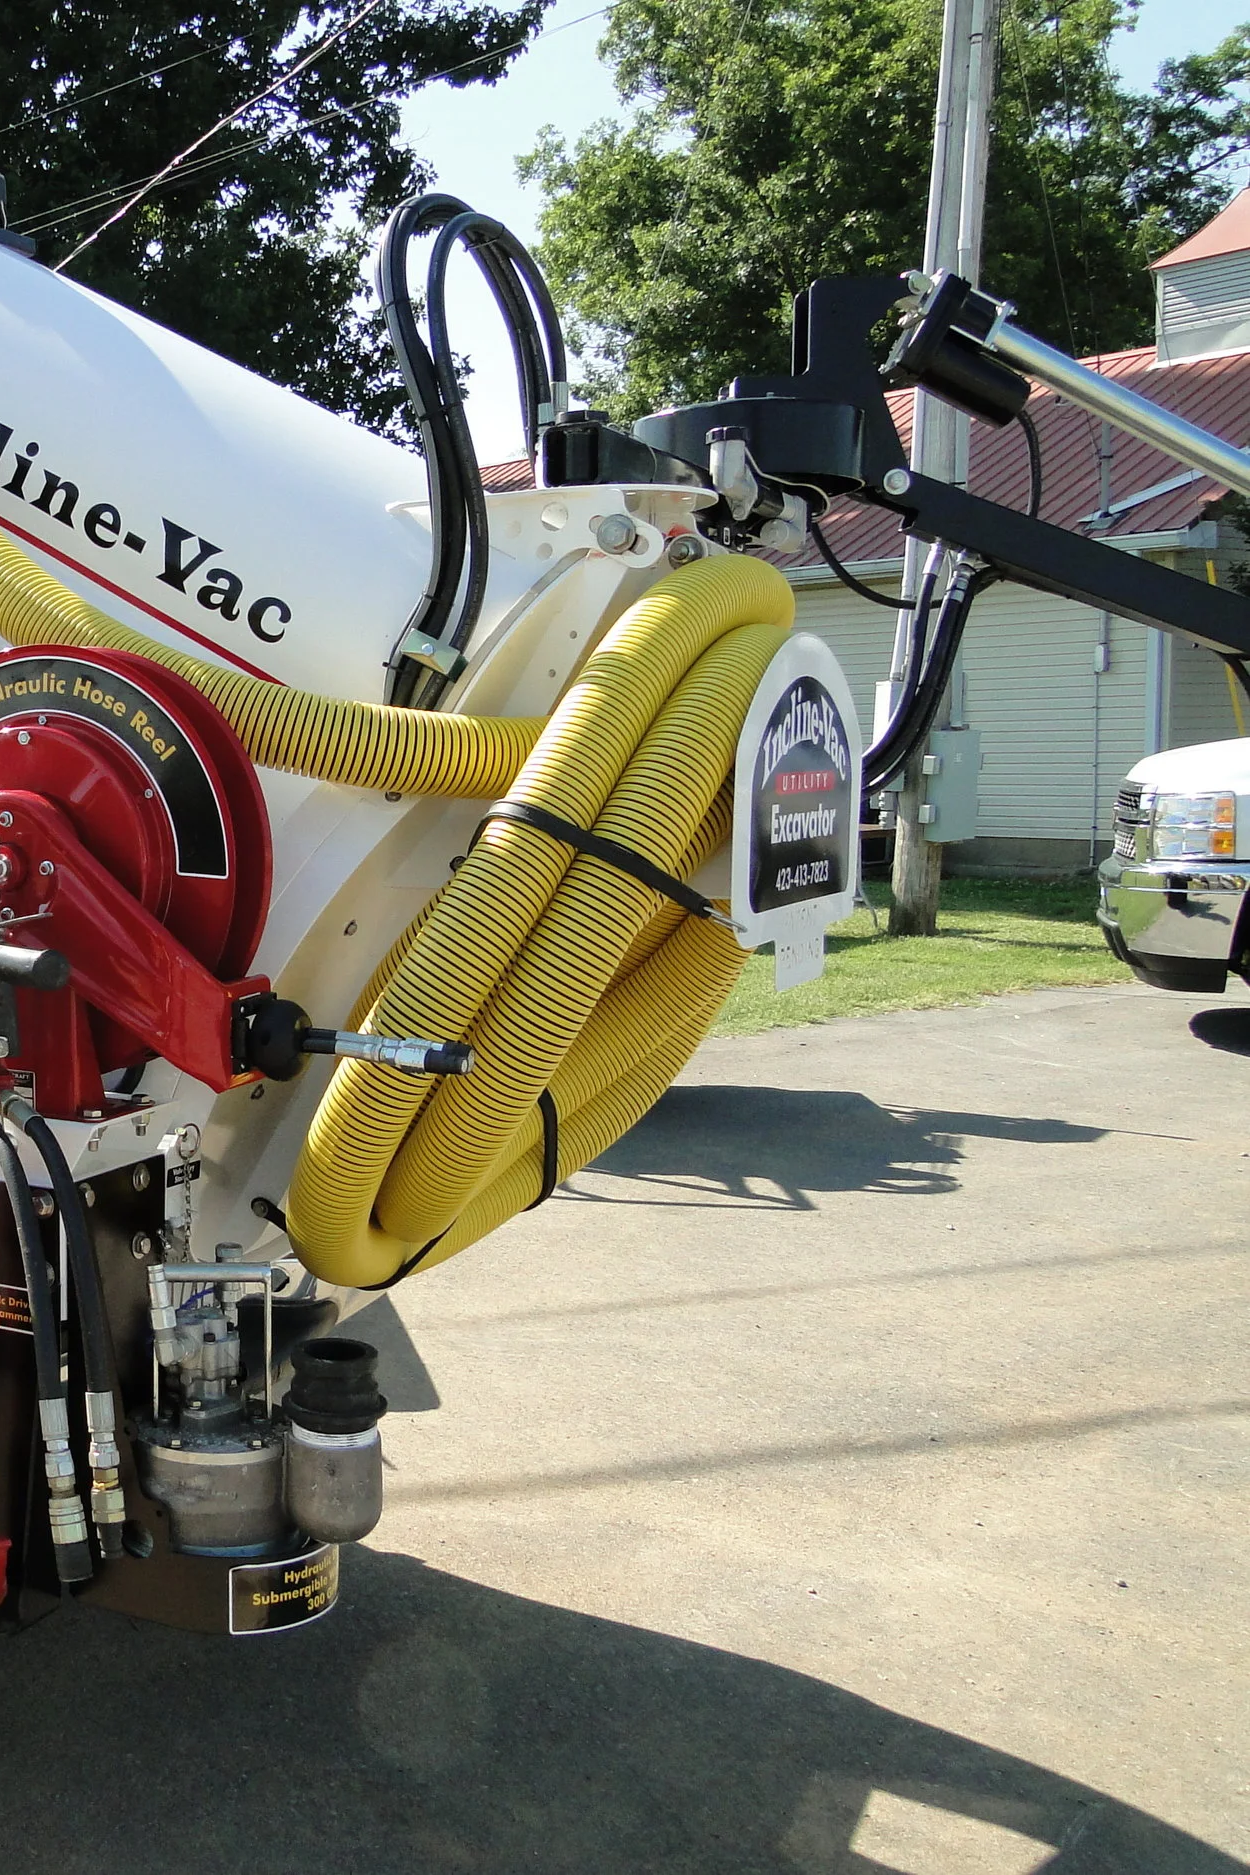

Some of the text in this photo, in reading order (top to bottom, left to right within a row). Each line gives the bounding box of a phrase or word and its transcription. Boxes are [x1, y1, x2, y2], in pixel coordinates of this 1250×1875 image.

[72, 676, 128, 718] Hose
[129, 709, 177, 762] Reel
[761, 686, 847, 790] Incline-Vac
[782, 773, 829, 792] UTILITY
[770, 803, 837, 845] Excavator
[775, 859, 830, 892] 423-413-7823
[252, 1574, 328, 1606] Submergible
[307, 1592, 326, 1611] 300
